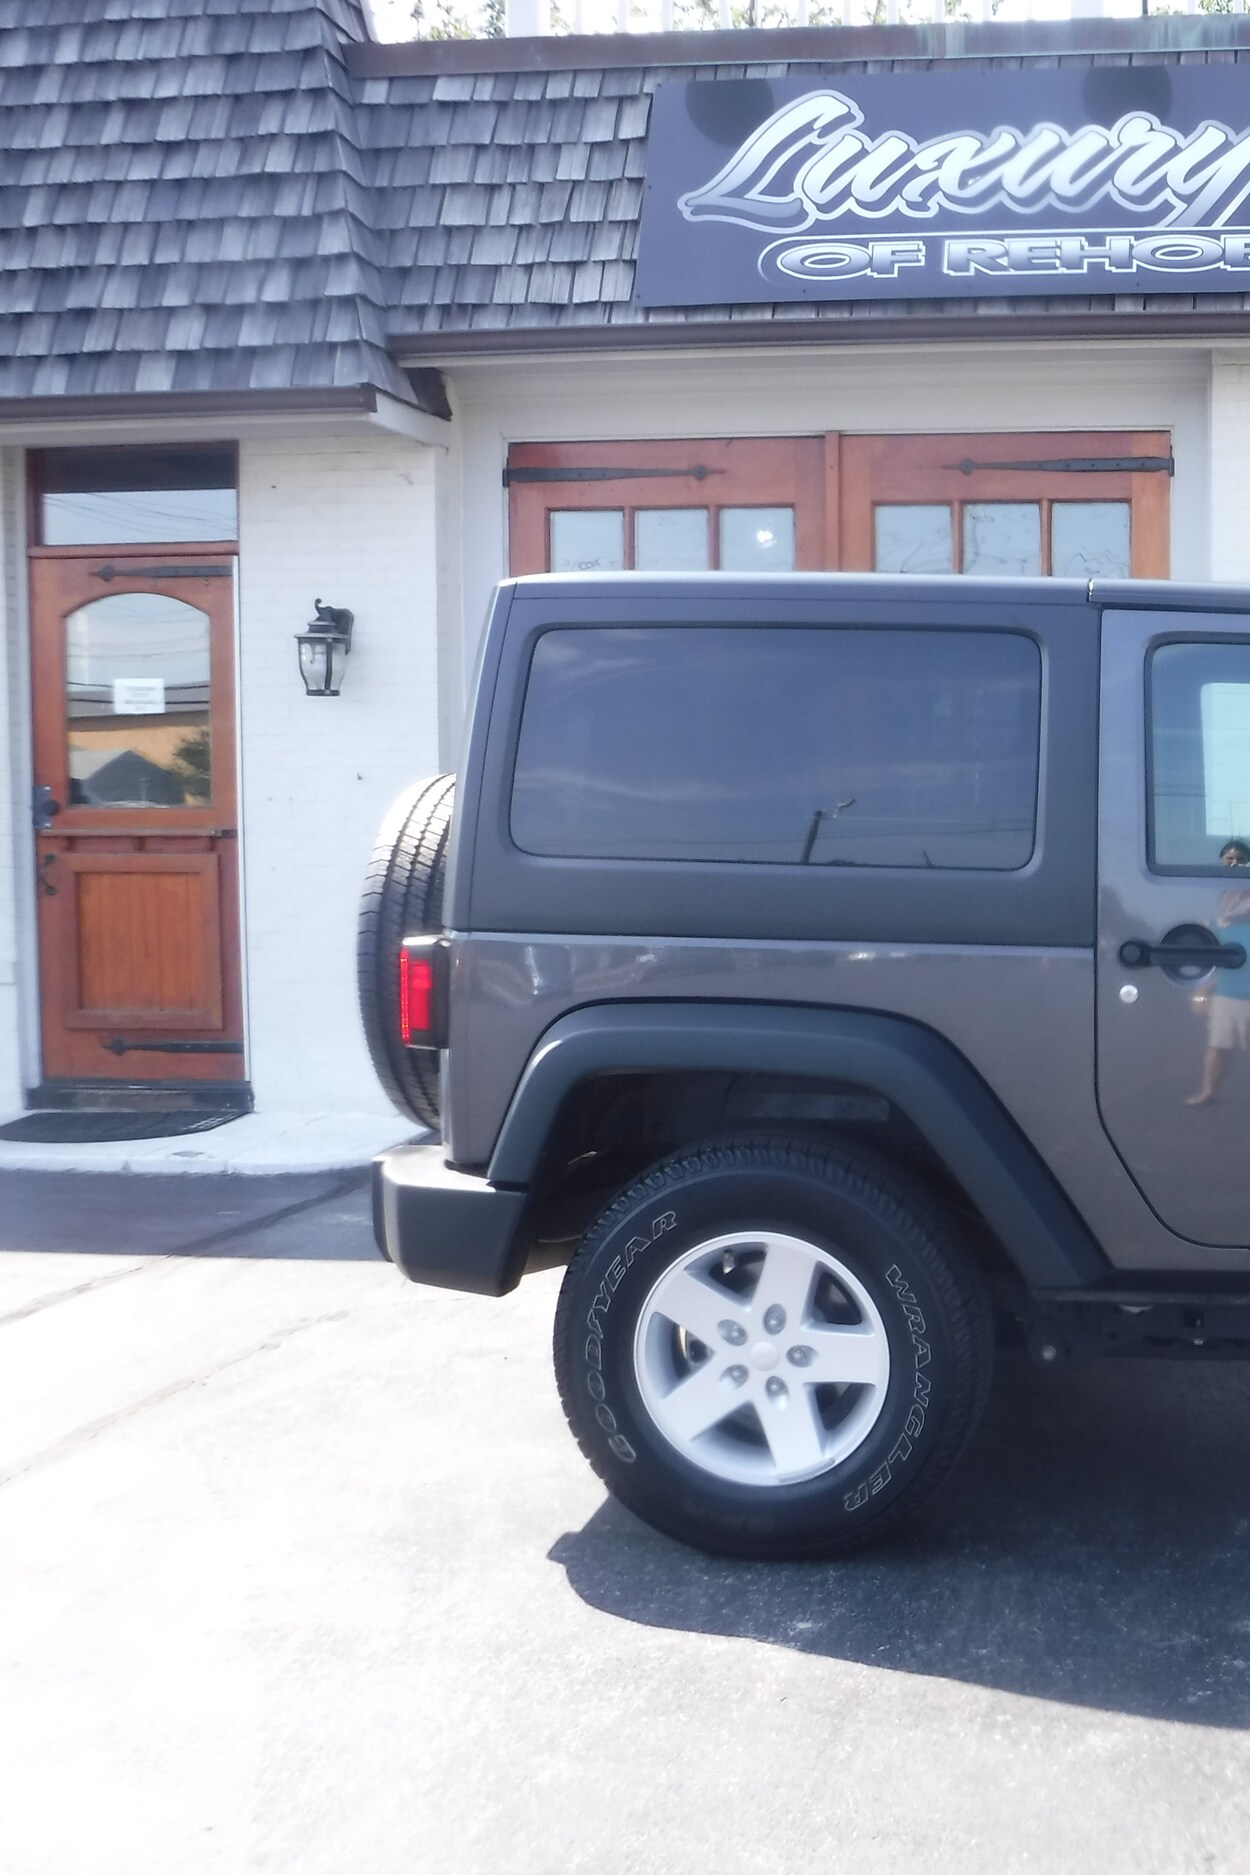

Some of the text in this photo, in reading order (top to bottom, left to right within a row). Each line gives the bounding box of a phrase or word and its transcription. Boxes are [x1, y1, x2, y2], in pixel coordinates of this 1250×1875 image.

[775, 239, 926, 281] OF
[584, 1210, 678, 1464] GOODYEAR
[843, 1264, 933, 1512] WRANGLER
